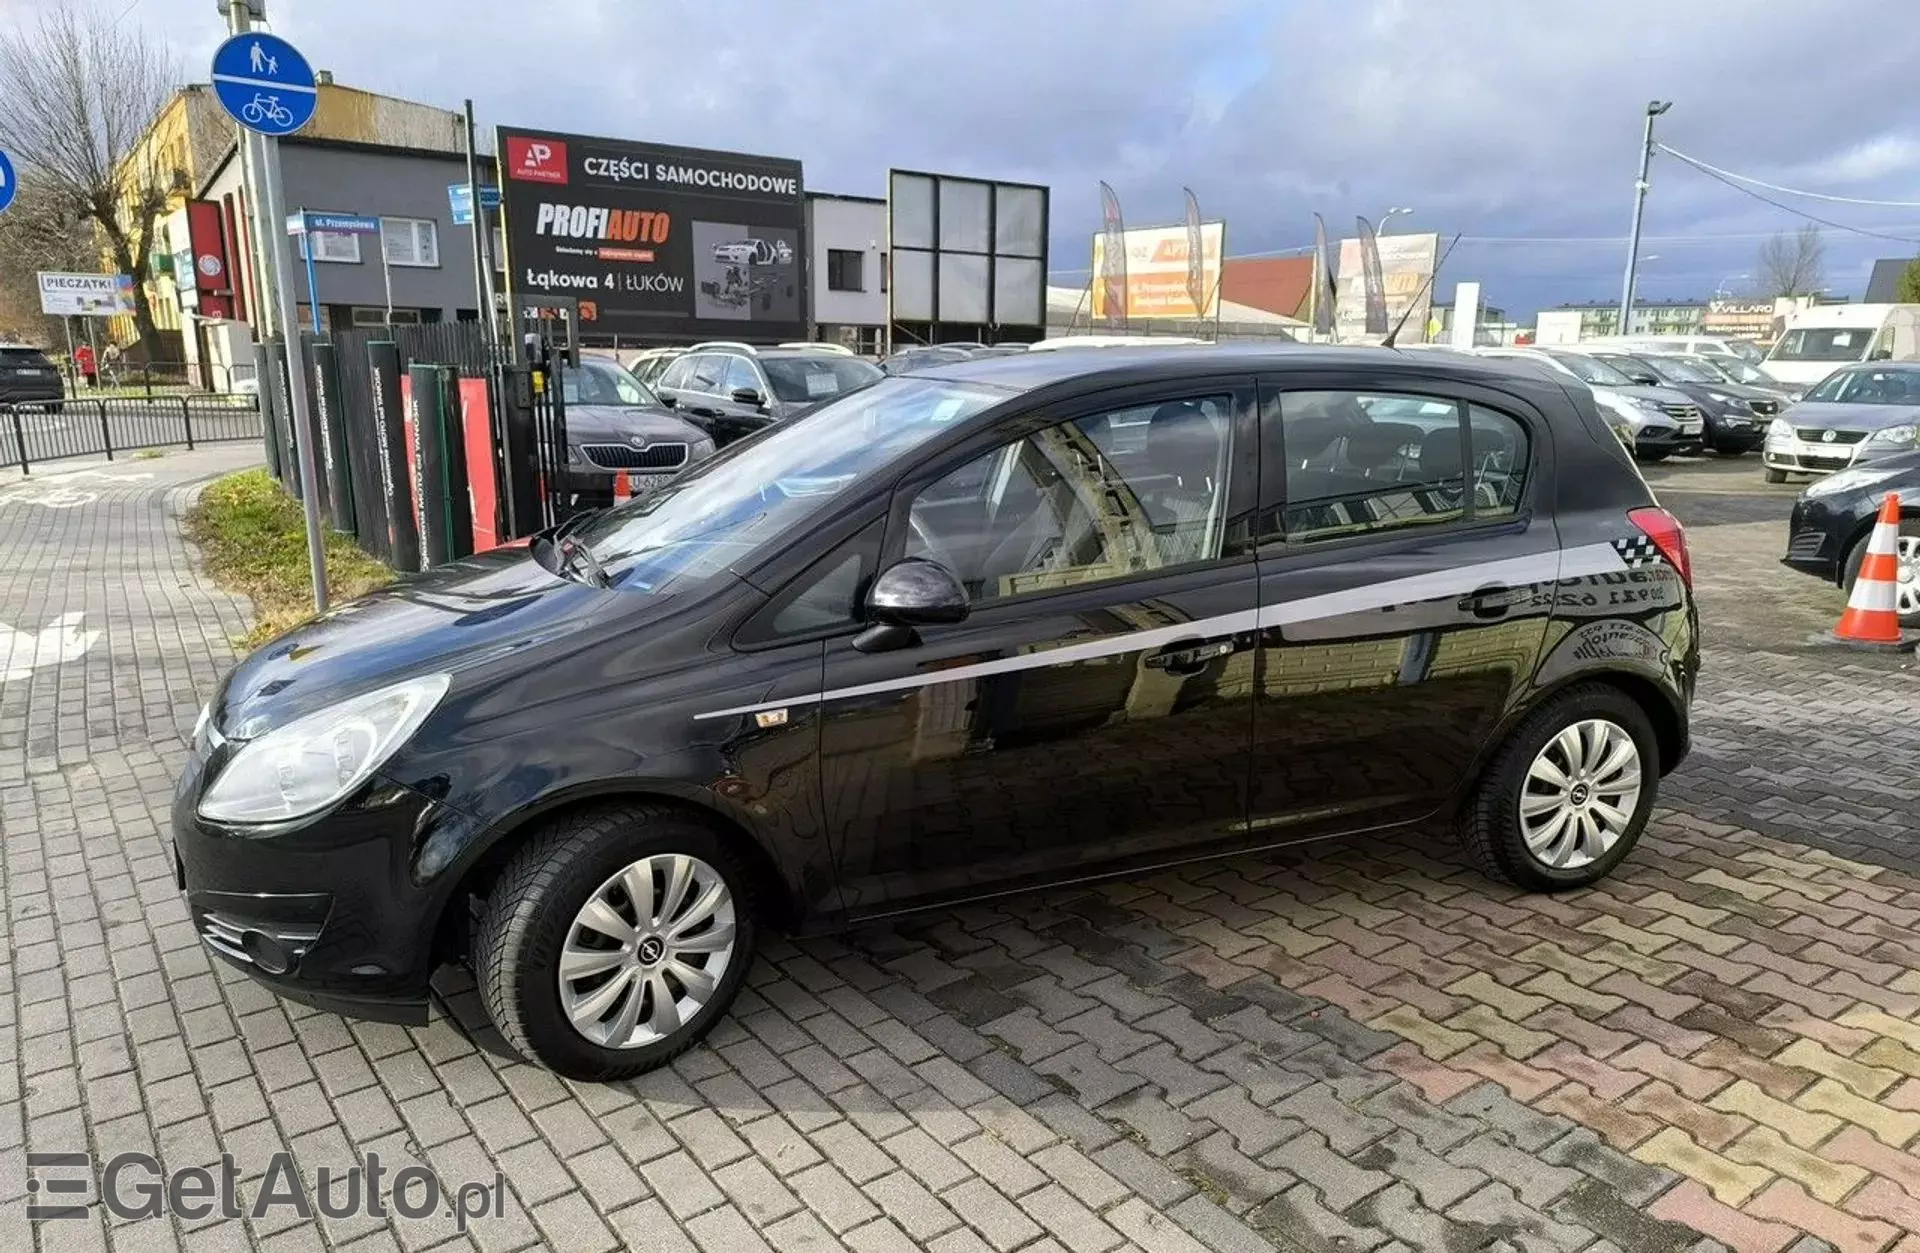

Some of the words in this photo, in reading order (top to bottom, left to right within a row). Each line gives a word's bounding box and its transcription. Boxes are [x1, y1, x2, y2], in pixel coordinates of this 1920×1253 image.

[583, 156, 650, 182] CZĘŚCI
[656, 160, 797, 196] SAMOCHODOWE
[536, 202, 671, 244] PROFIAUTO
[46, 277, 112, 290] PIECZĄTKI
[526, 268, 598, 290] Łąkowa
[604, 272, 614, 290] 4
[626, 273, 684, 293] ŁUKÓW
